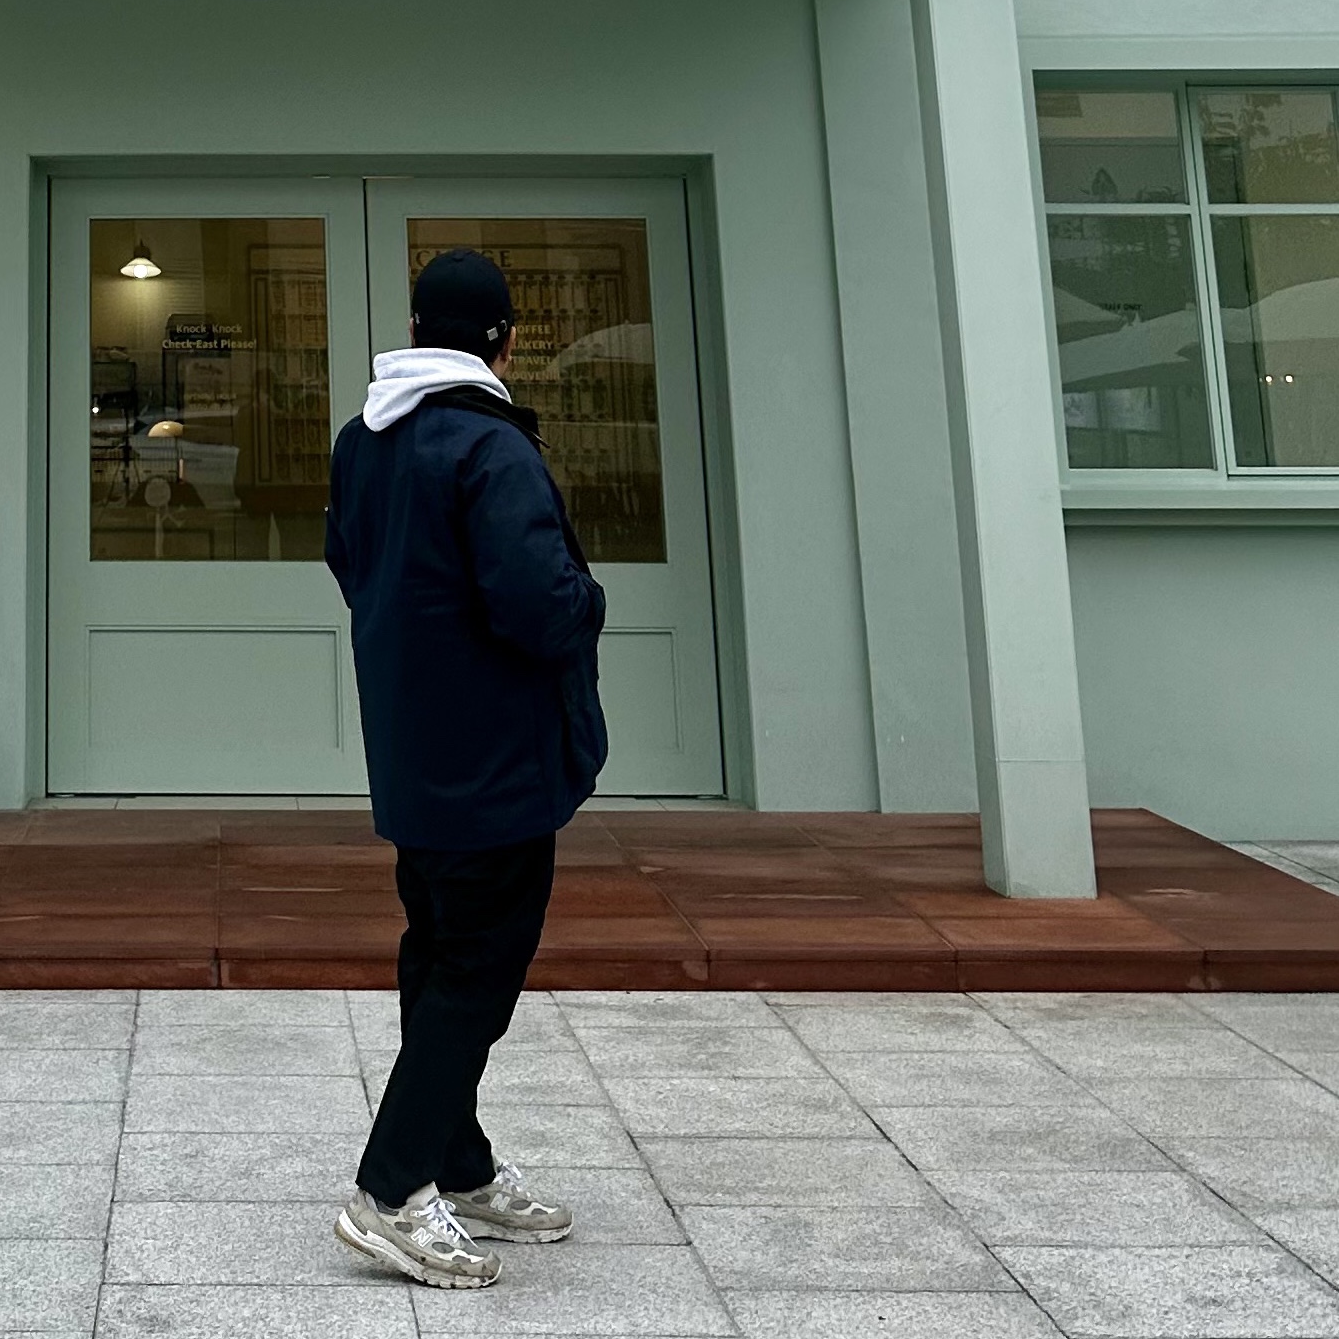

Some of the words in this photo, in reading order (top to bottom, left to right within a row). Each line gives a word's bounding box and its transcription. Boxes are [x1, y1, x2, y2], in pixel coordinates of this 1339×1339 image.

[176, 324, 207, 334] Knock
[212, 323, 243, 333] Knock
[516, 325, 551, 335] OFFEE
[162, 339, 218, 349] Check-East
[220, 338, 257, 349] Please!
